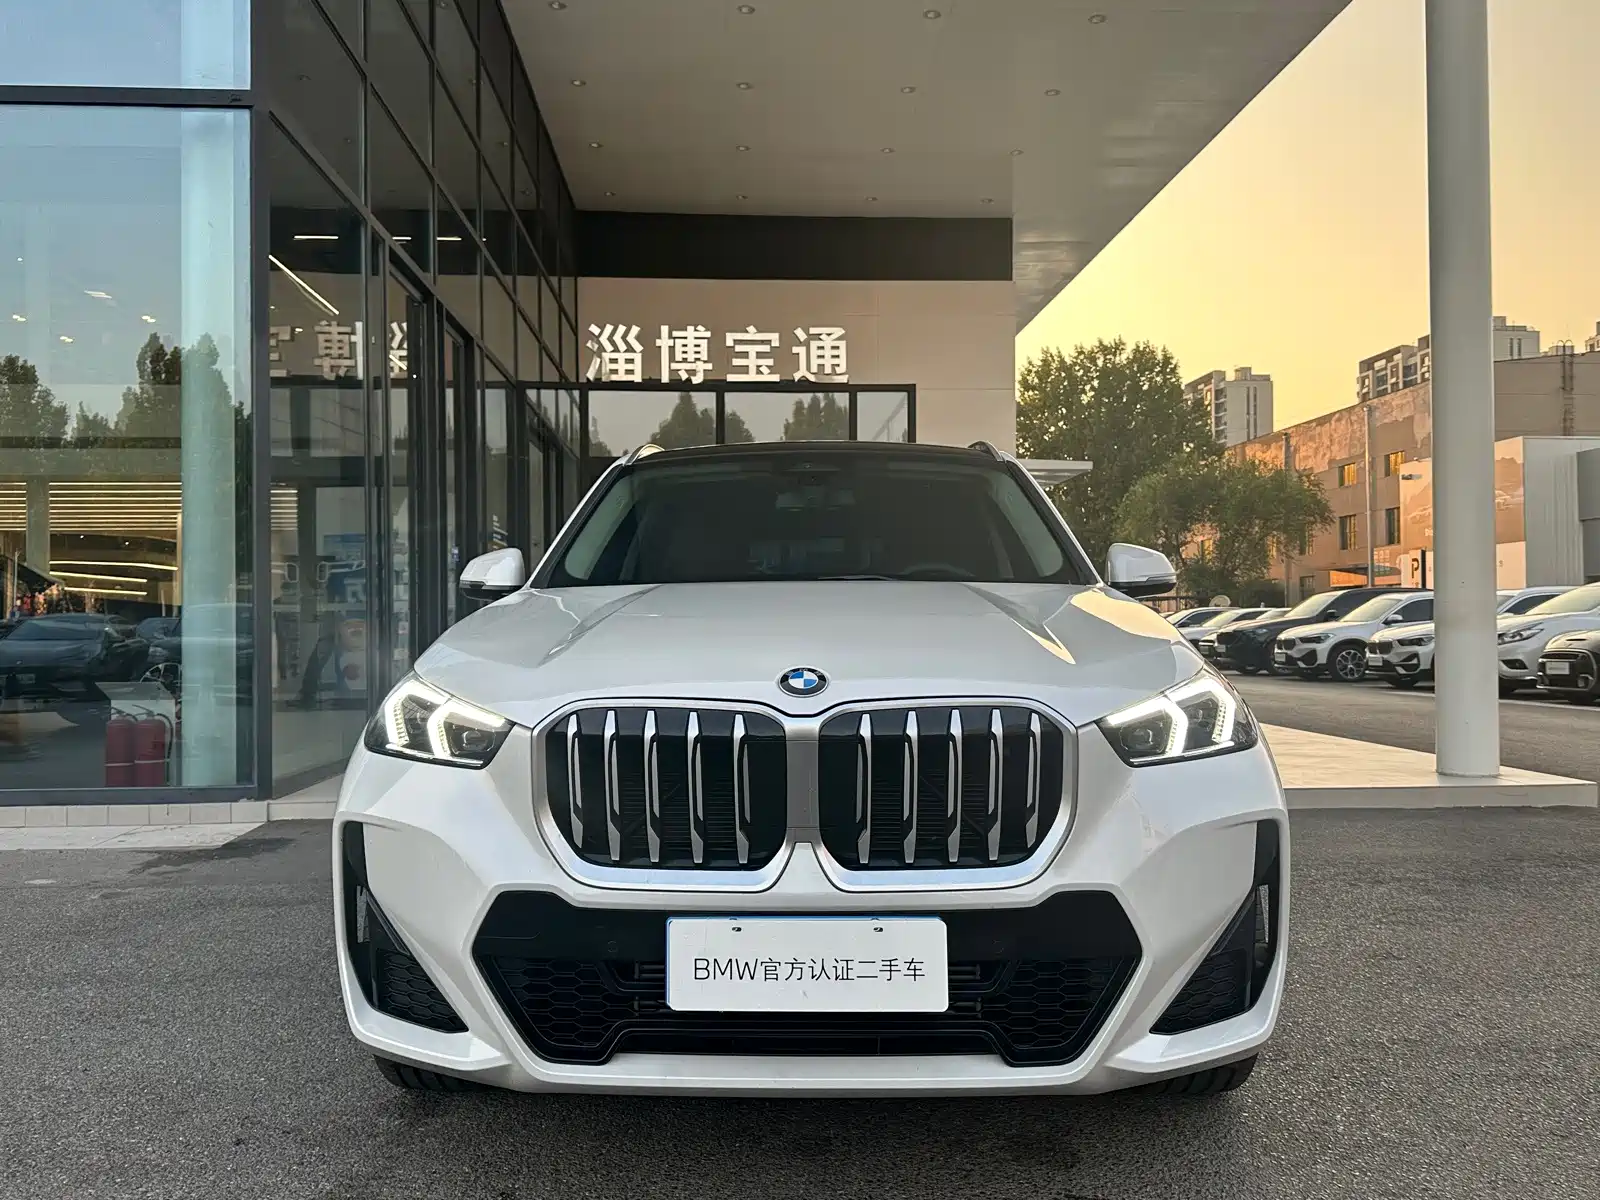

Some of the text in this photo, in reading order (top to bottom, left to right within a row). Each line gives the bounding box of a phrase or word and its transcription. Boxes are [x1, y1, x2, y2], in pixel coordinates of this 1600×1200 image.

[586, 323, 849, 384] 淄博宝通
[693, 957, 926, 982] BMW官方认证二手车
